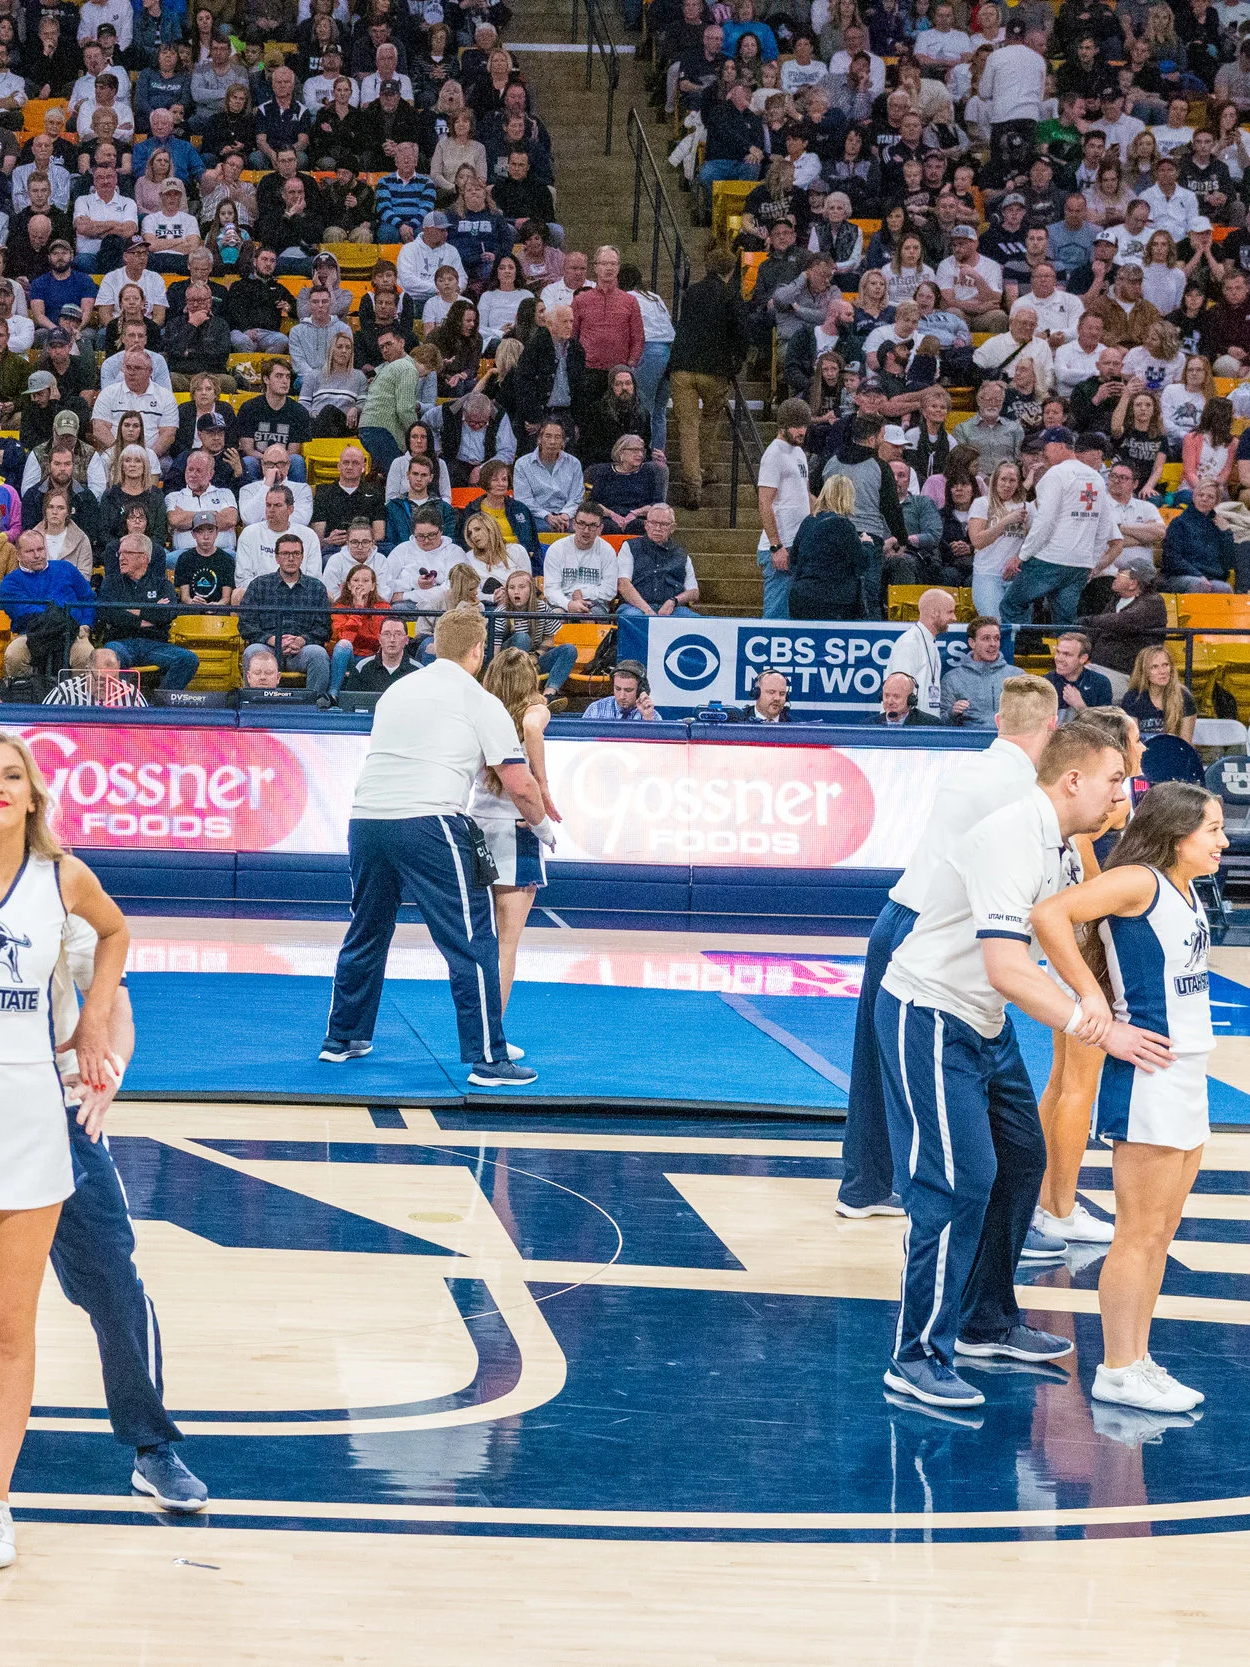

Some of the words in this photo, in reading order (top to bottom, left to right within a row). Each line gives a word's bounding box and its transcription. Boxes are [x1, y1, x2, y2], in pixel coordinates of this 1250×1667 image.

[155, 228, 184, 237] STATE
[253, 430, 289, 444] STATE
[744, 636, 814, 664] CBS
[824, 637, 970, 667] SPOTS
[744, 666, 889, 693] NETWO
[572, 747, 842, 854] Gossner
[82, 812, 233, 839] FOODS
[650, 828, 800, 855] FOODS
[987, 912, 1004, 922] UTAH
[1004, 914, 1024, 924] STATE
